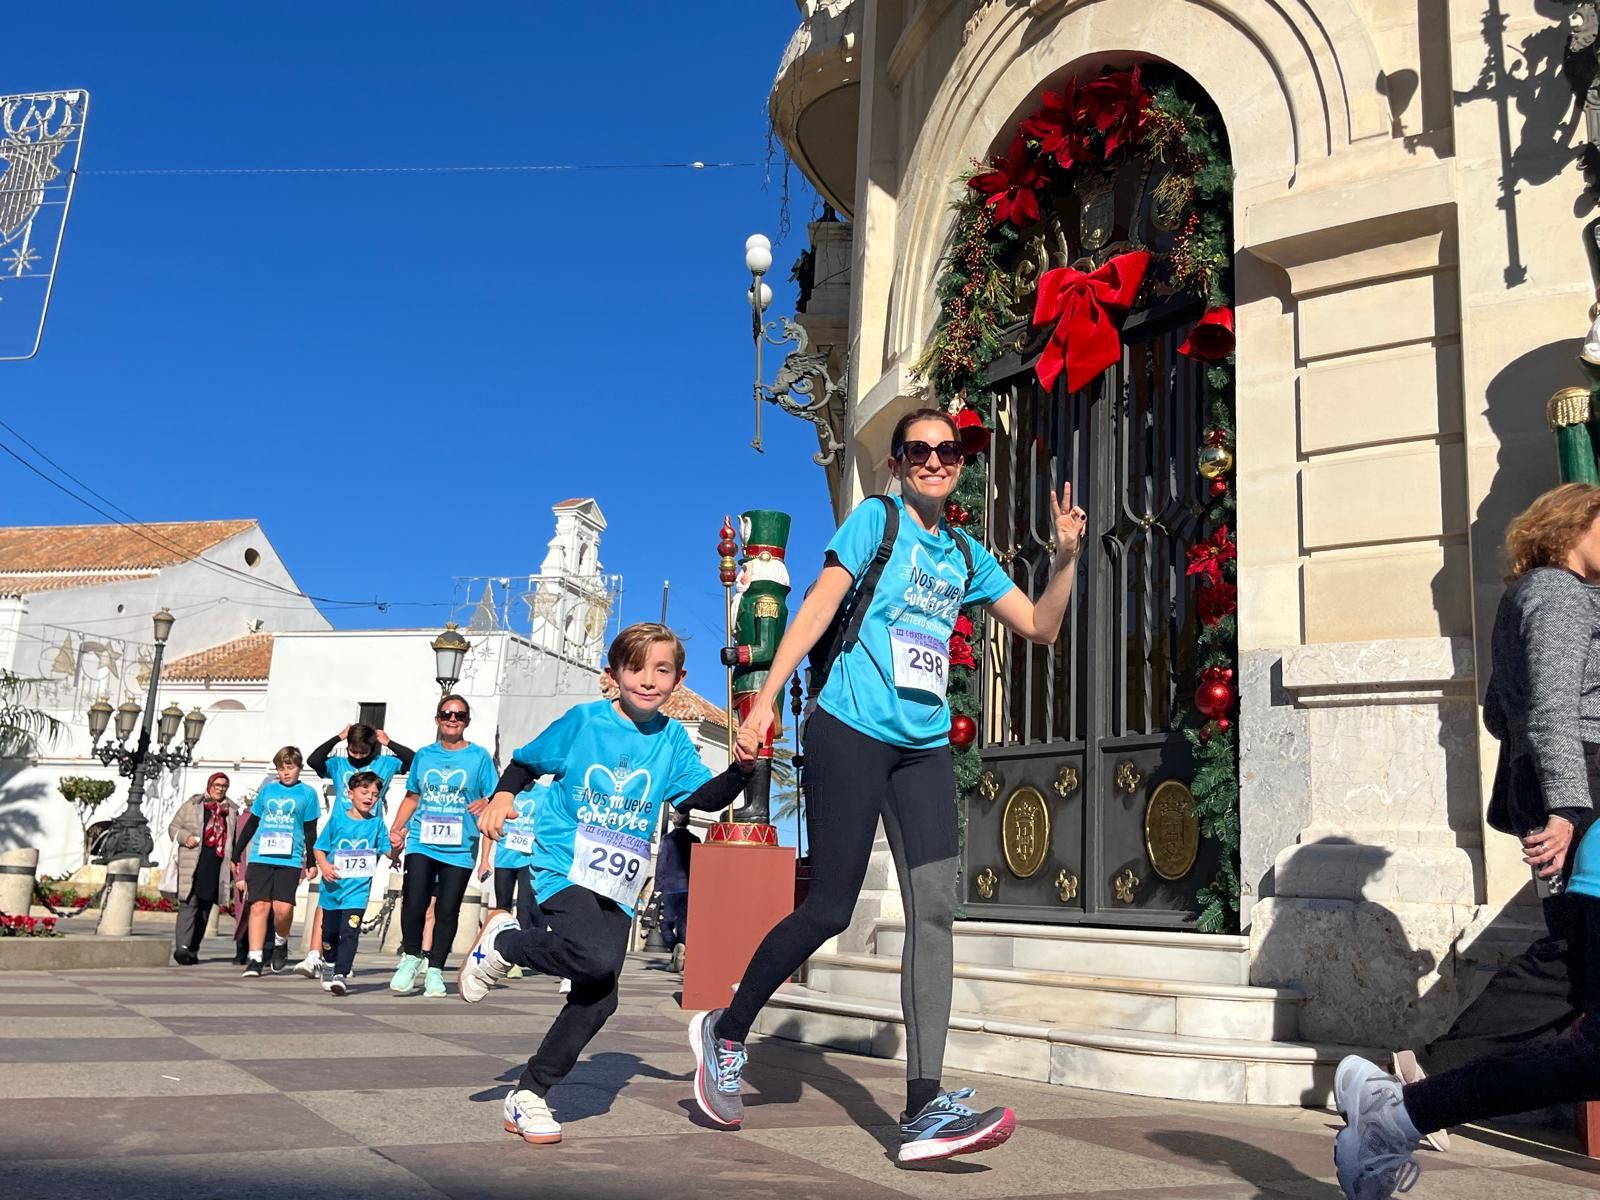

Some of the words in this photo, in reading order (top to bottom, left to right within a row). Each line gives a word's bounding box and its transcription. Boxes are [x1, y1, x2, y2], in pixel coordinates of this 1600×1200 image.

[910, 567, 935, 588] Nos
[908, 647, 943, 679] 298
[582, 787, 609, 806] Nos
[609, 795, 653, 814] mueve
[432, 825, 451, 835] 171
[584, 825, 596, 834] III
[511, 836, 529, 846] 206
[345, 859, 367, 868] 173
[589, 847, 640, 882] 299
